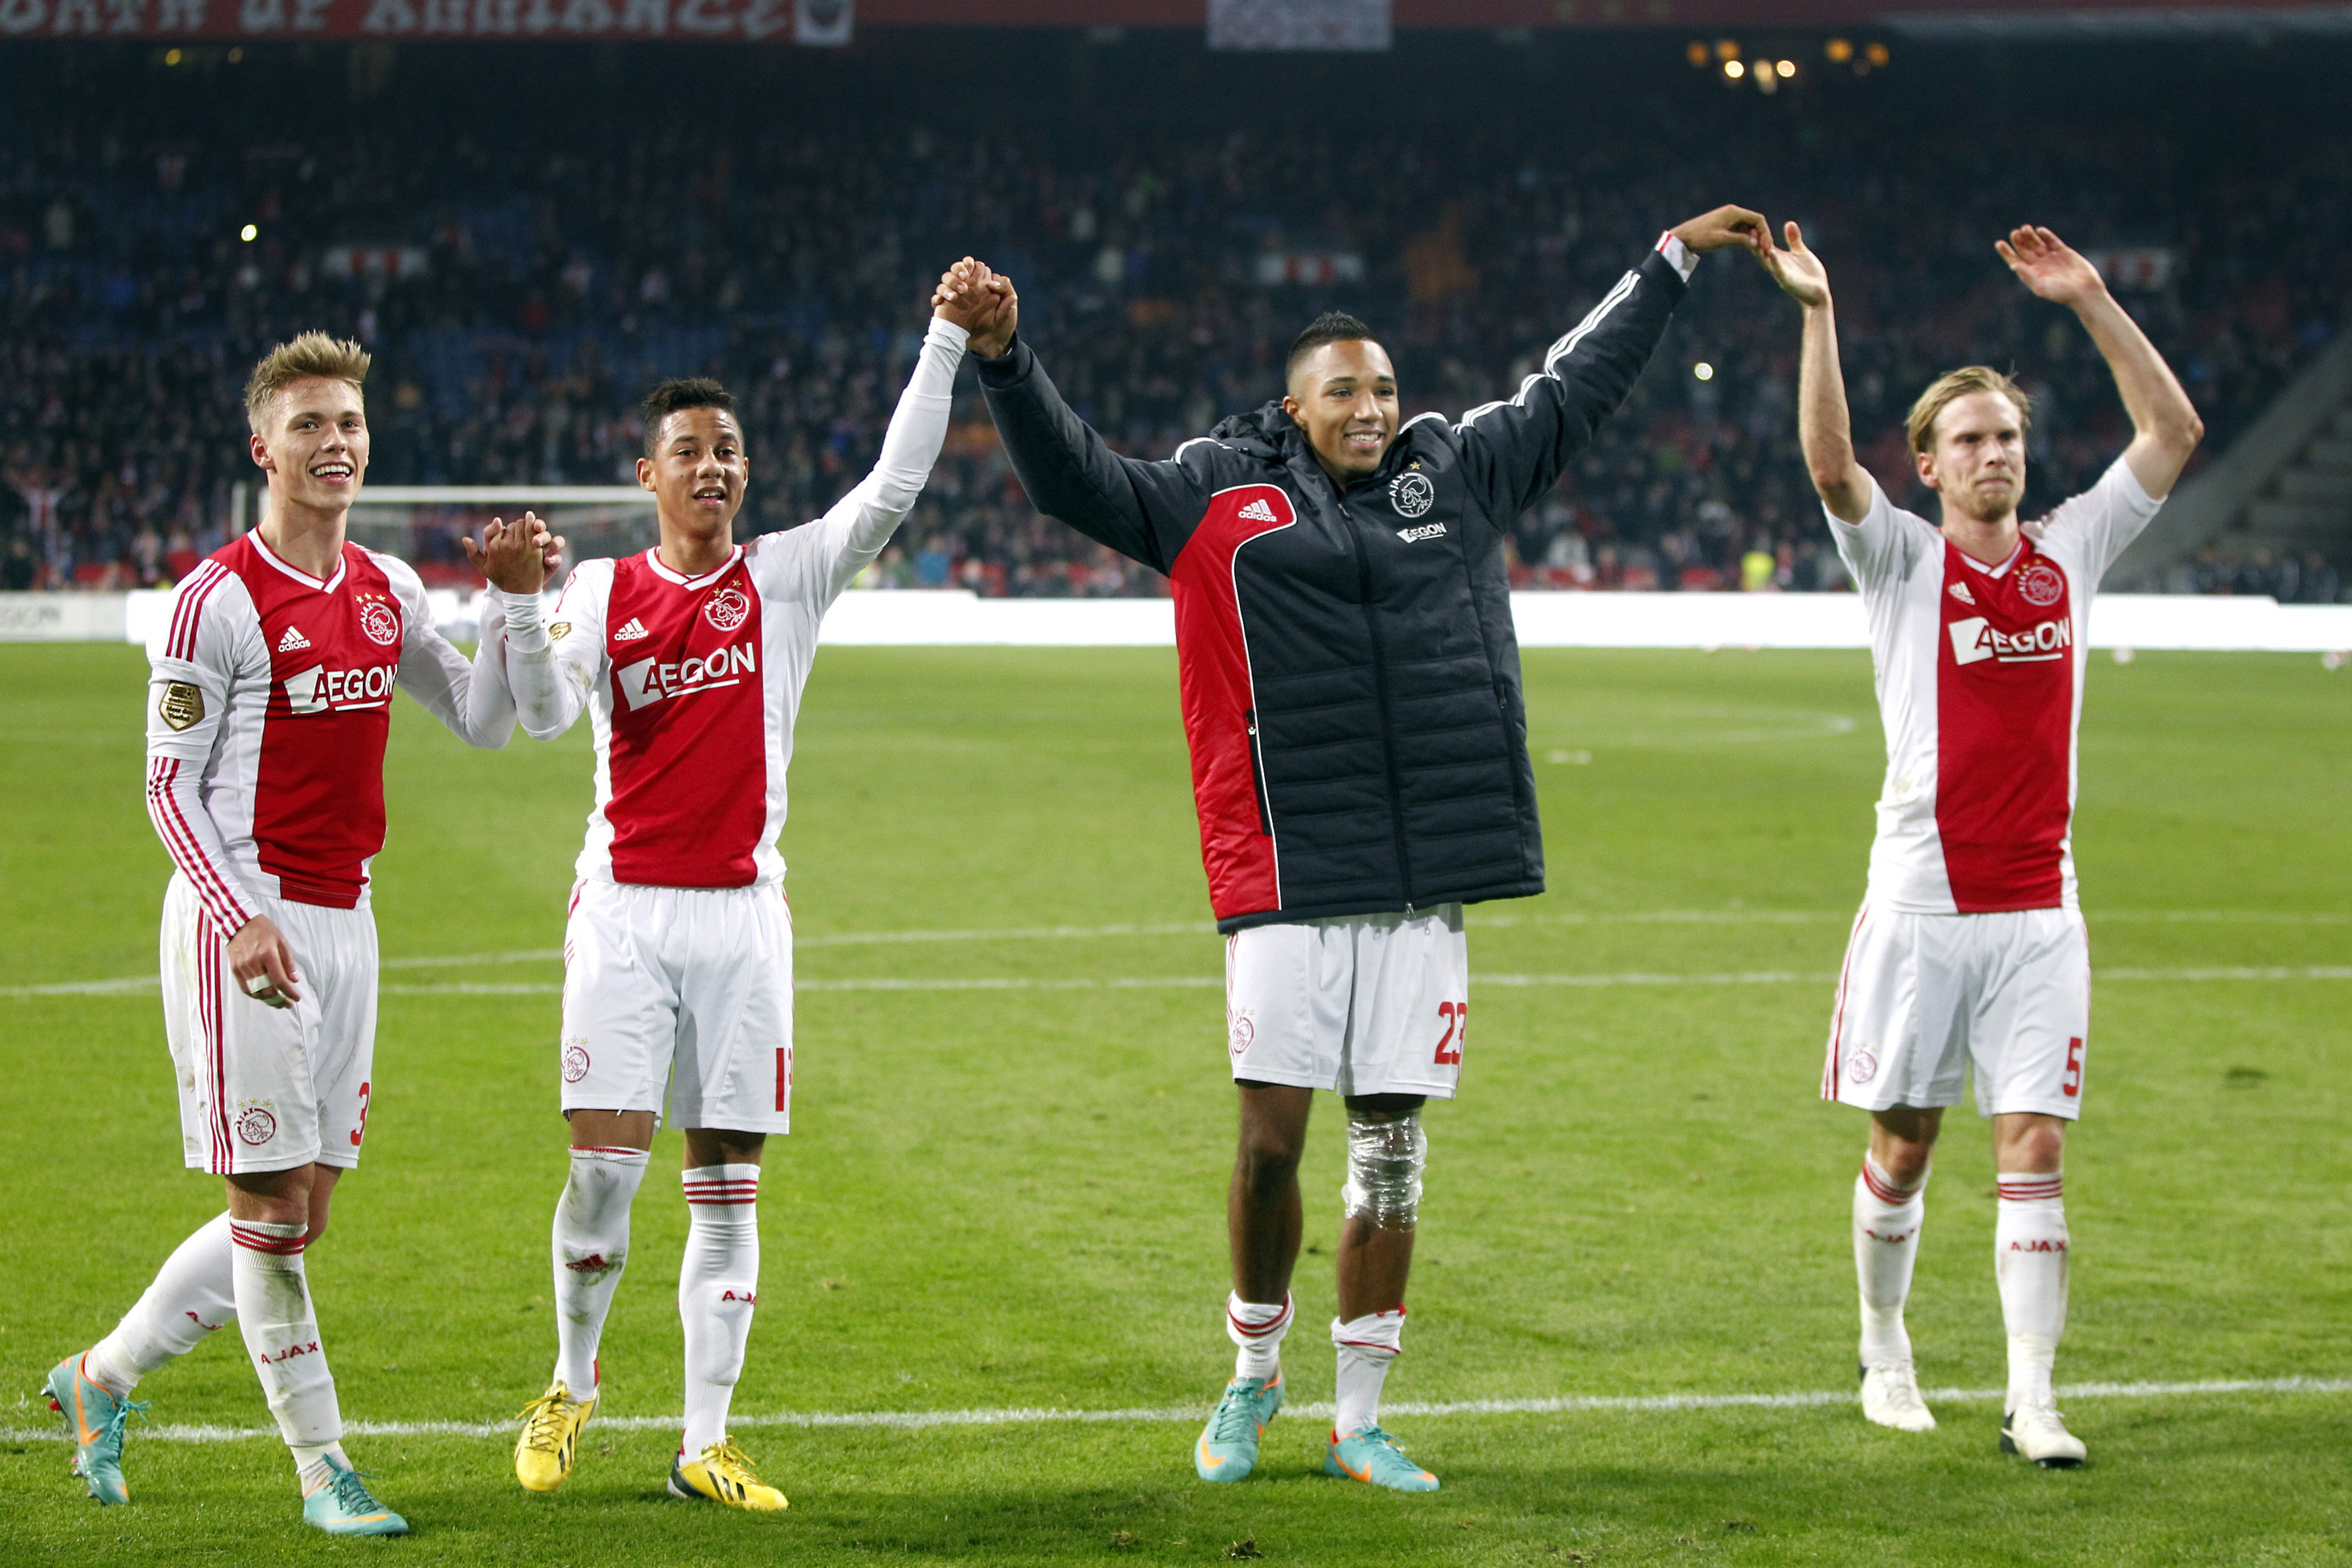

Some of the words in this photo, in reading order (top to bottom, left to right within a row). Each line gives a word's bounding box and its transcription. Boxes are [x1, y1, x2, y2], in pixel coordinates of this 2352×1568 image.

[1389, 474, 1407, 498] AJAX
[1238, 510, 1277, 522] adidas
[1407, 522, 1447, 539] AEGON
[360, 602, 374, 624] AJAX
[277, 639, 311, 653] adidas
[613, 629, 649, 641] adidas
[1974, 617, 2072, 653] AEGON
[641, 642, 756, 694] AEGON
[310, 664, 398, 704] AEGON
[2063, 1036, 2084, 1097] 5
[775, 1048, 793, 1112] 1
[350, 1082, 370, 1147] 3
[2010, 1239, 2066, 1253] AJAX
[260, 1341, 319, 1364] AJAX
